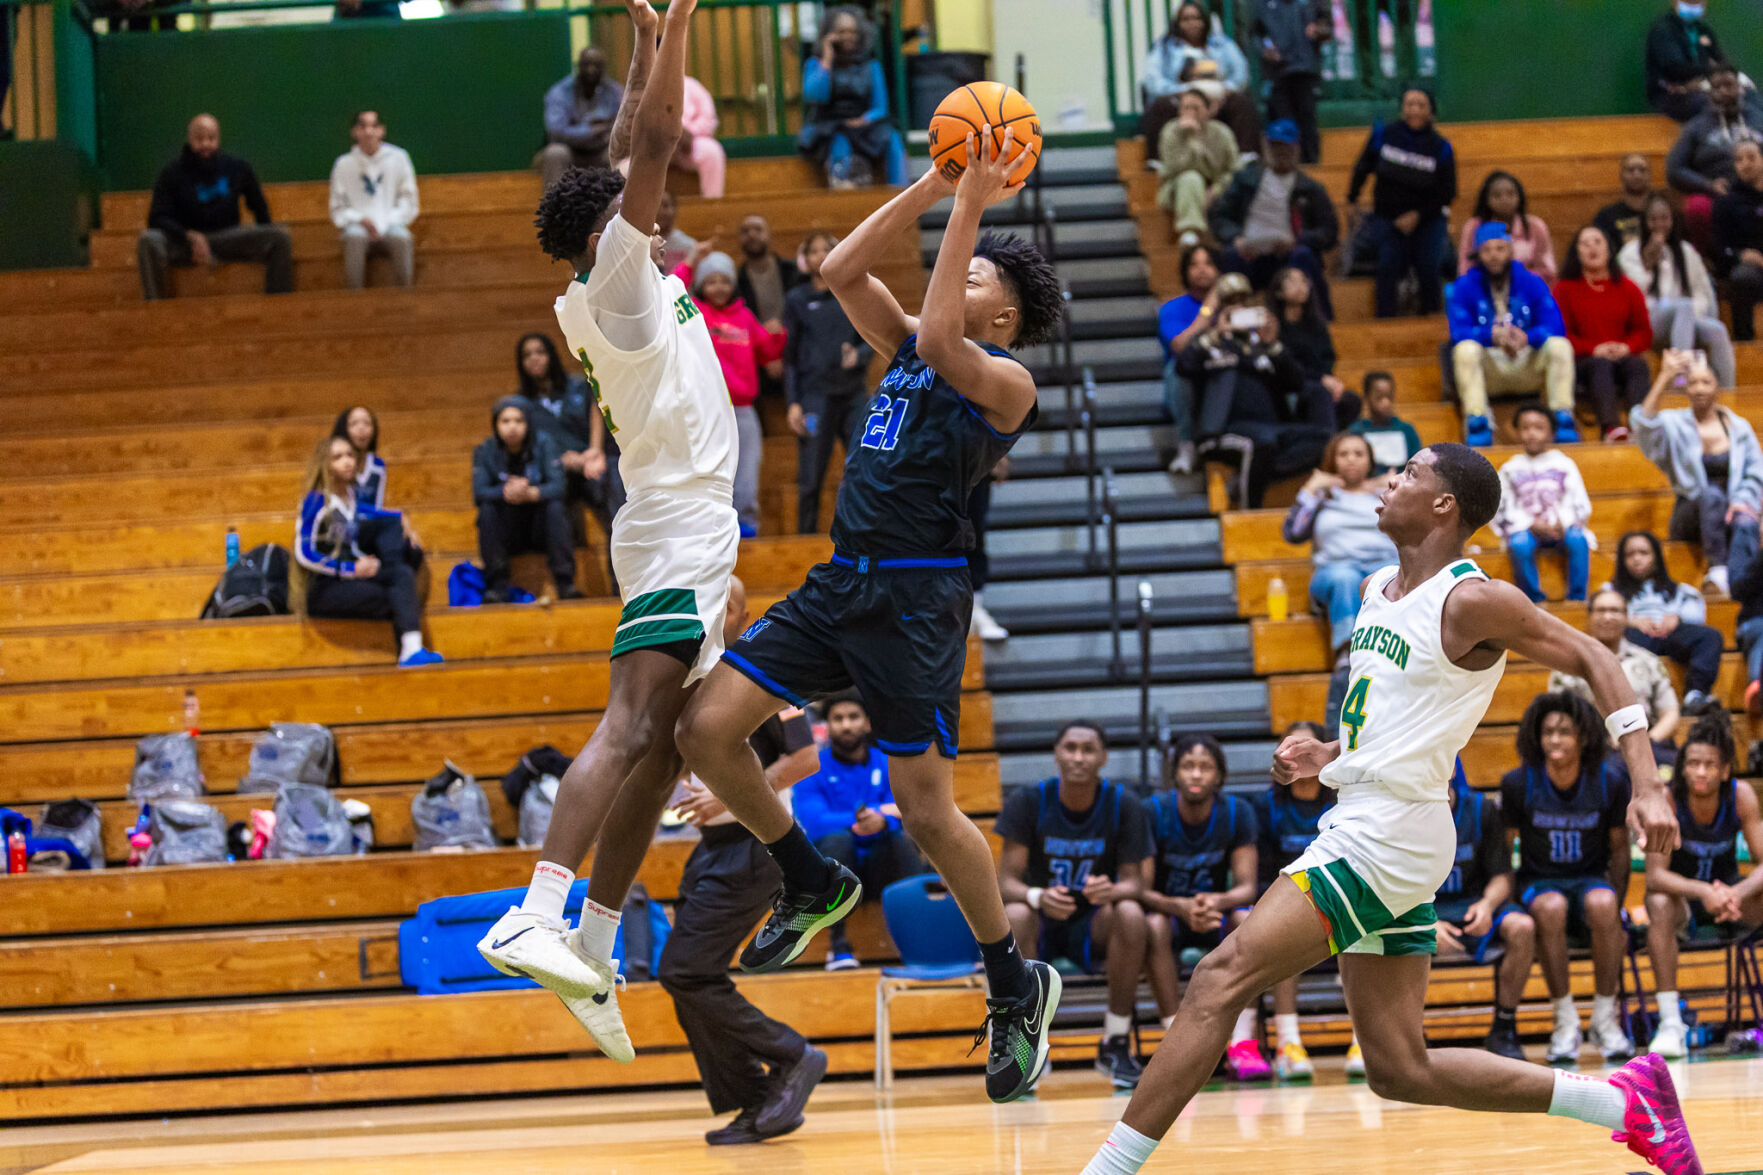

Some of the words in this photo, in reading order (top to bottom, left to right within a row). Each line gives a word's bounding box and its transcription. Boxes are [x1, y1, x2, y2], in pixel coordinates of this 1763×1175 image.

[861, 393, 910, 450] 21
[1341, 675, 1373, 751] 4
[536, 864, 568, 880] upreme
